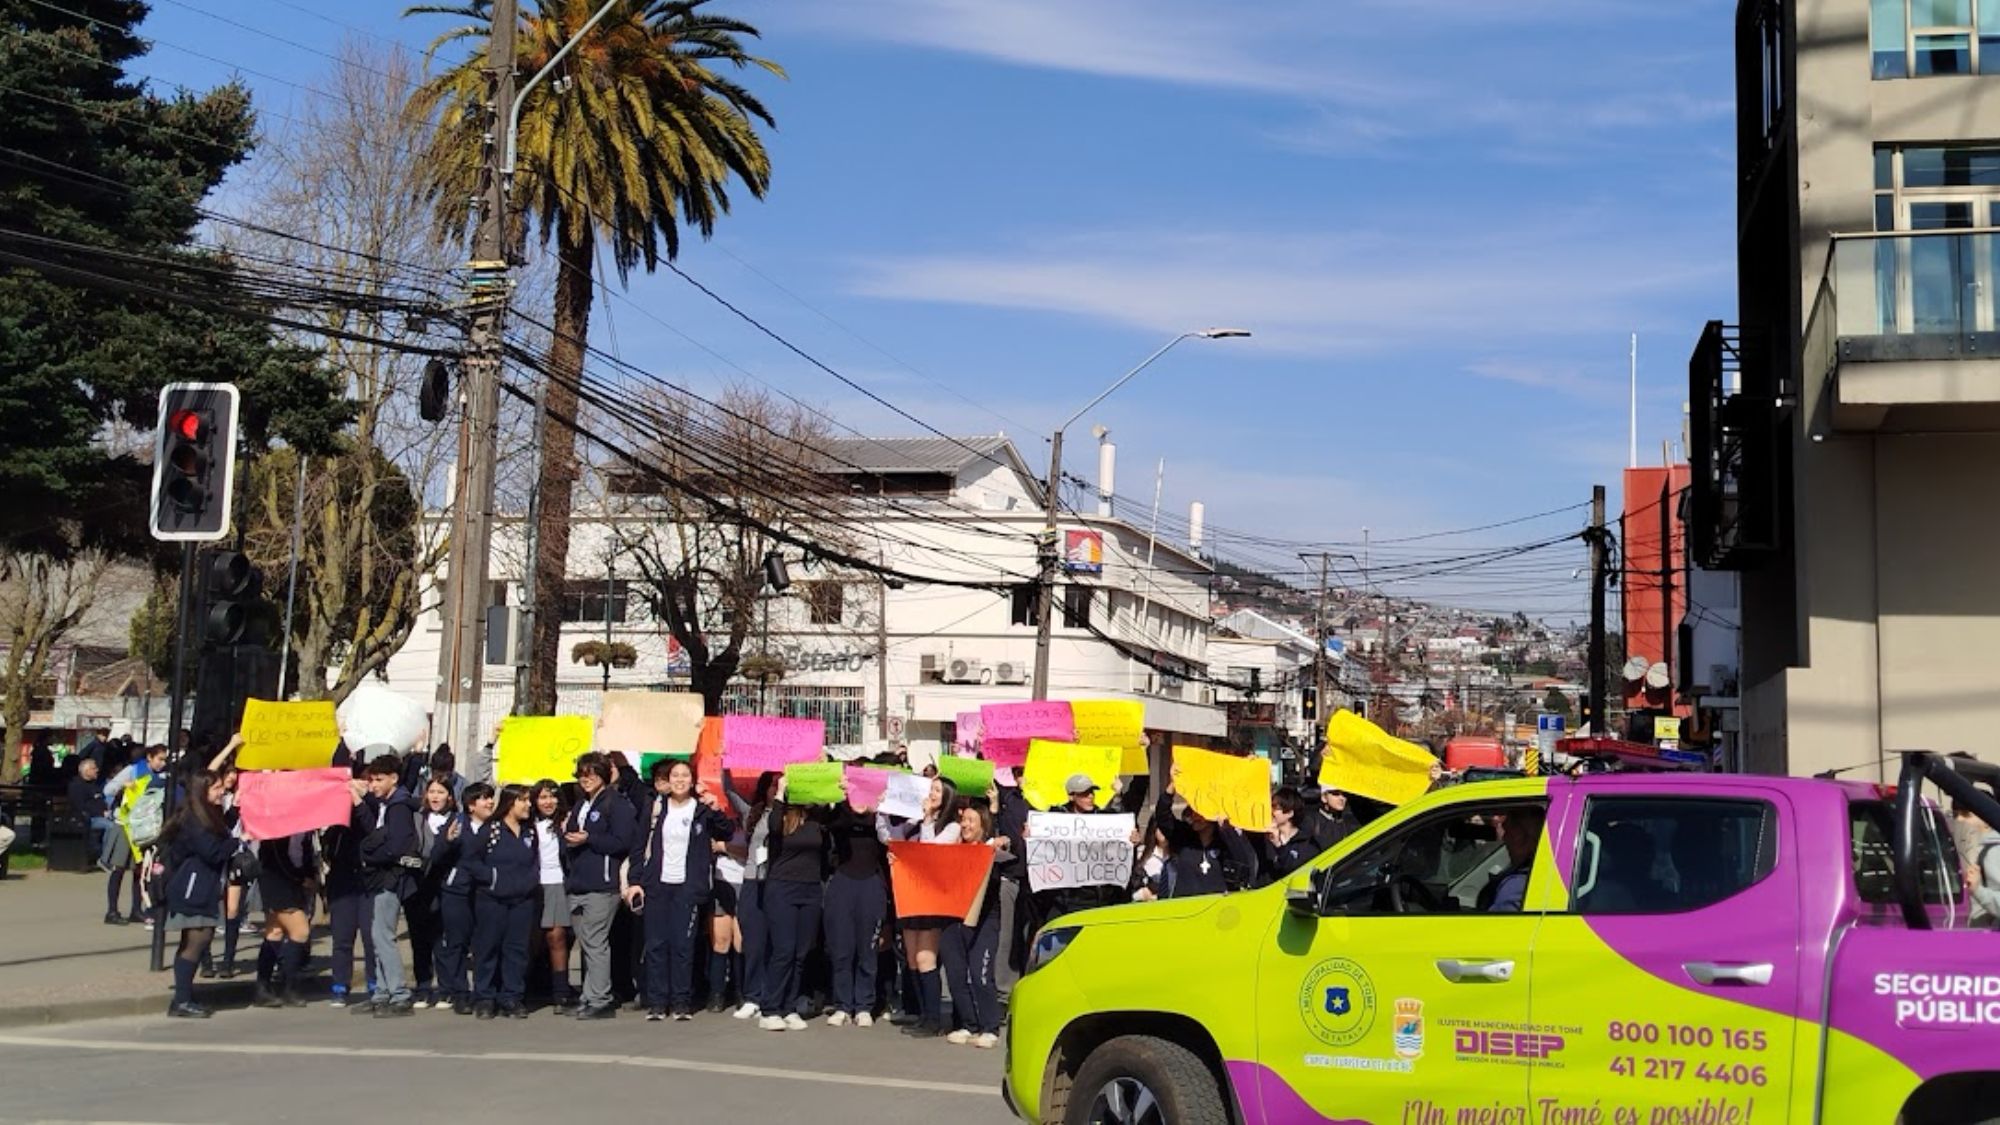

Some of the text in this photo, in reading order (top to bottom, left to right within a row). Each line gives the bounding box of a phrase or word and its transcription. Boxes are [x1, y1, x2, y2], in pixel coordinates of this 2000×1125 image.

[1031, 863, 1129, 883] NO LICEO
[1455, 1029, 1565, 1059] DISEP
[1608, 1021, 1767, 1051] 800 100 165
[1609, 1056, 1768, 1087] 41 217 4406
[1457, 1101, 1528, 1125] mejor
[1538, 1098, 1602, 1125] Tomé
[1615, 1103, 1639, 1125] es
[1651, 1098, 1754, 1125] posible!
